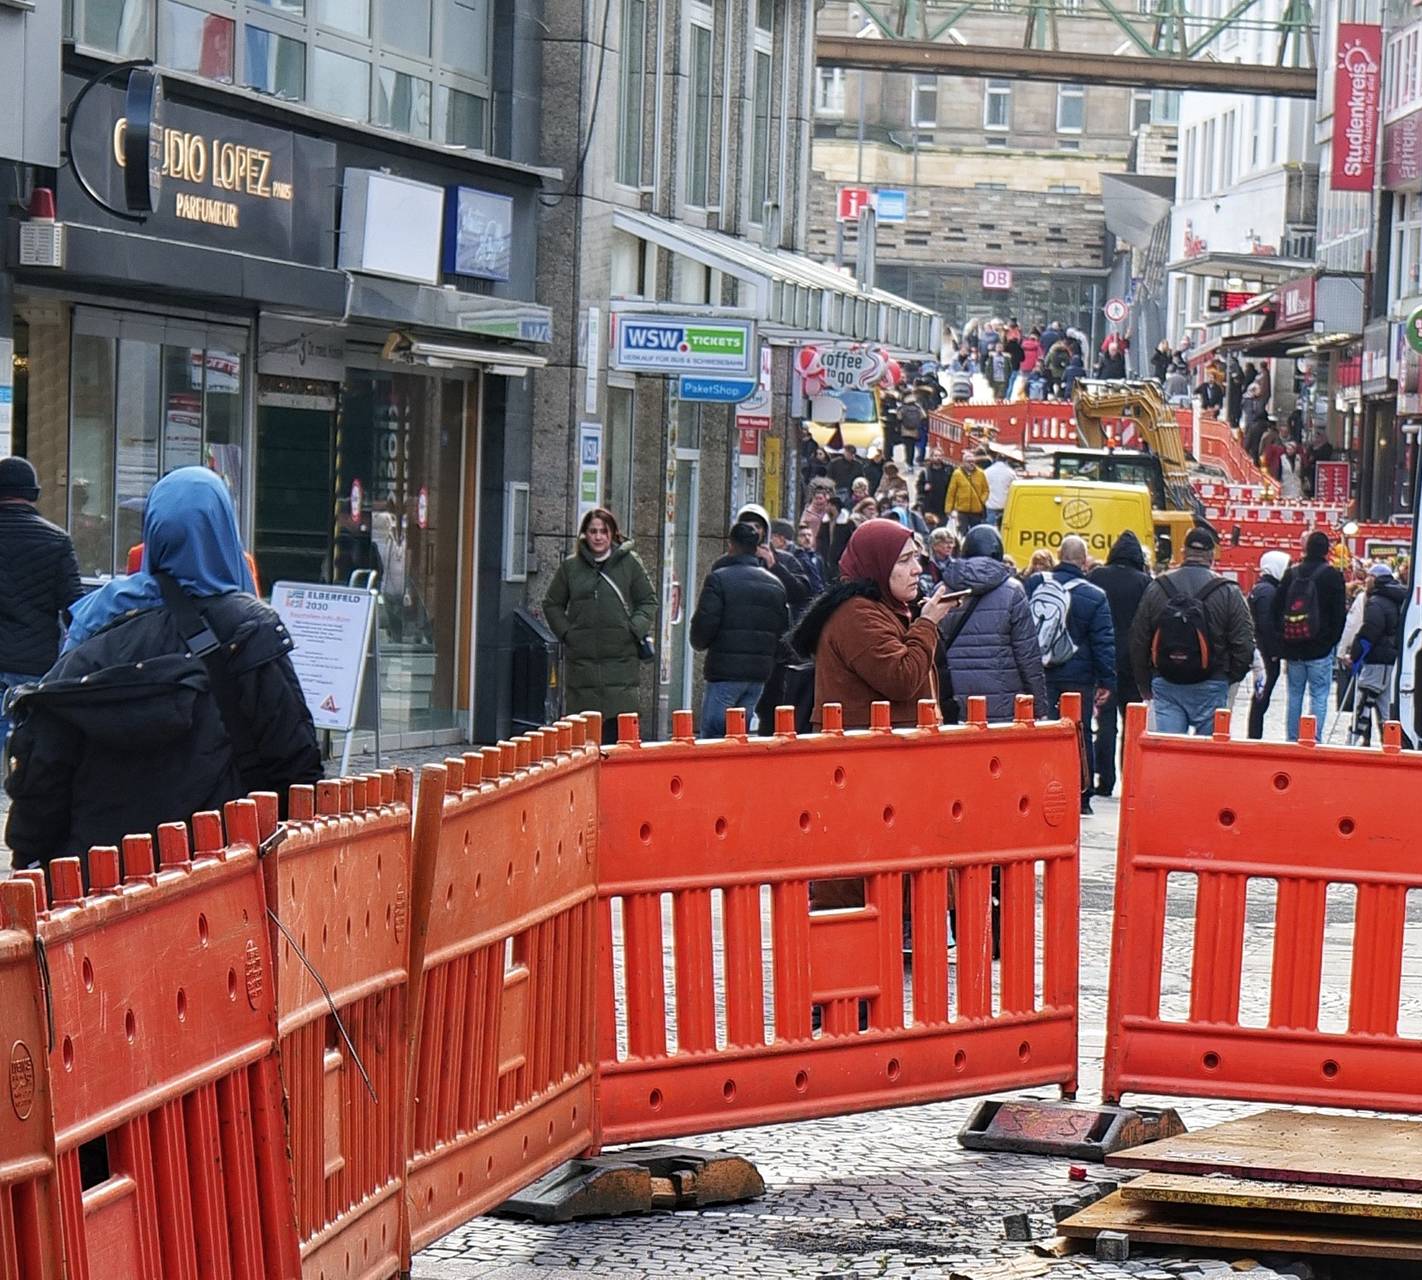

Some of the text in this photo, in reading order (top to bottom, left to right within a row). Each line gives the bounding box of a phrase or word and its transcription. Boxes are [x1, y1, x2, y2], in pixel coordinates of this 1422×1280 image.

[1344, 63, 1367, 176] Studienkreis
[212, 139, 272, 198] LOPEZ
[176, 193, 239, 228] PARFUMEUR
[986, 271, 1007, 286] DB
[628, 328, 741, 349] WSW TICKETS
[820, 353, 863, 370] coffee
[827, 369, 853, 387] to go
[684, 383, 740, 397] PaketShop
[308, 592, 360, 603] ELBERFELD
[306, 602, 328, 611] 2030
